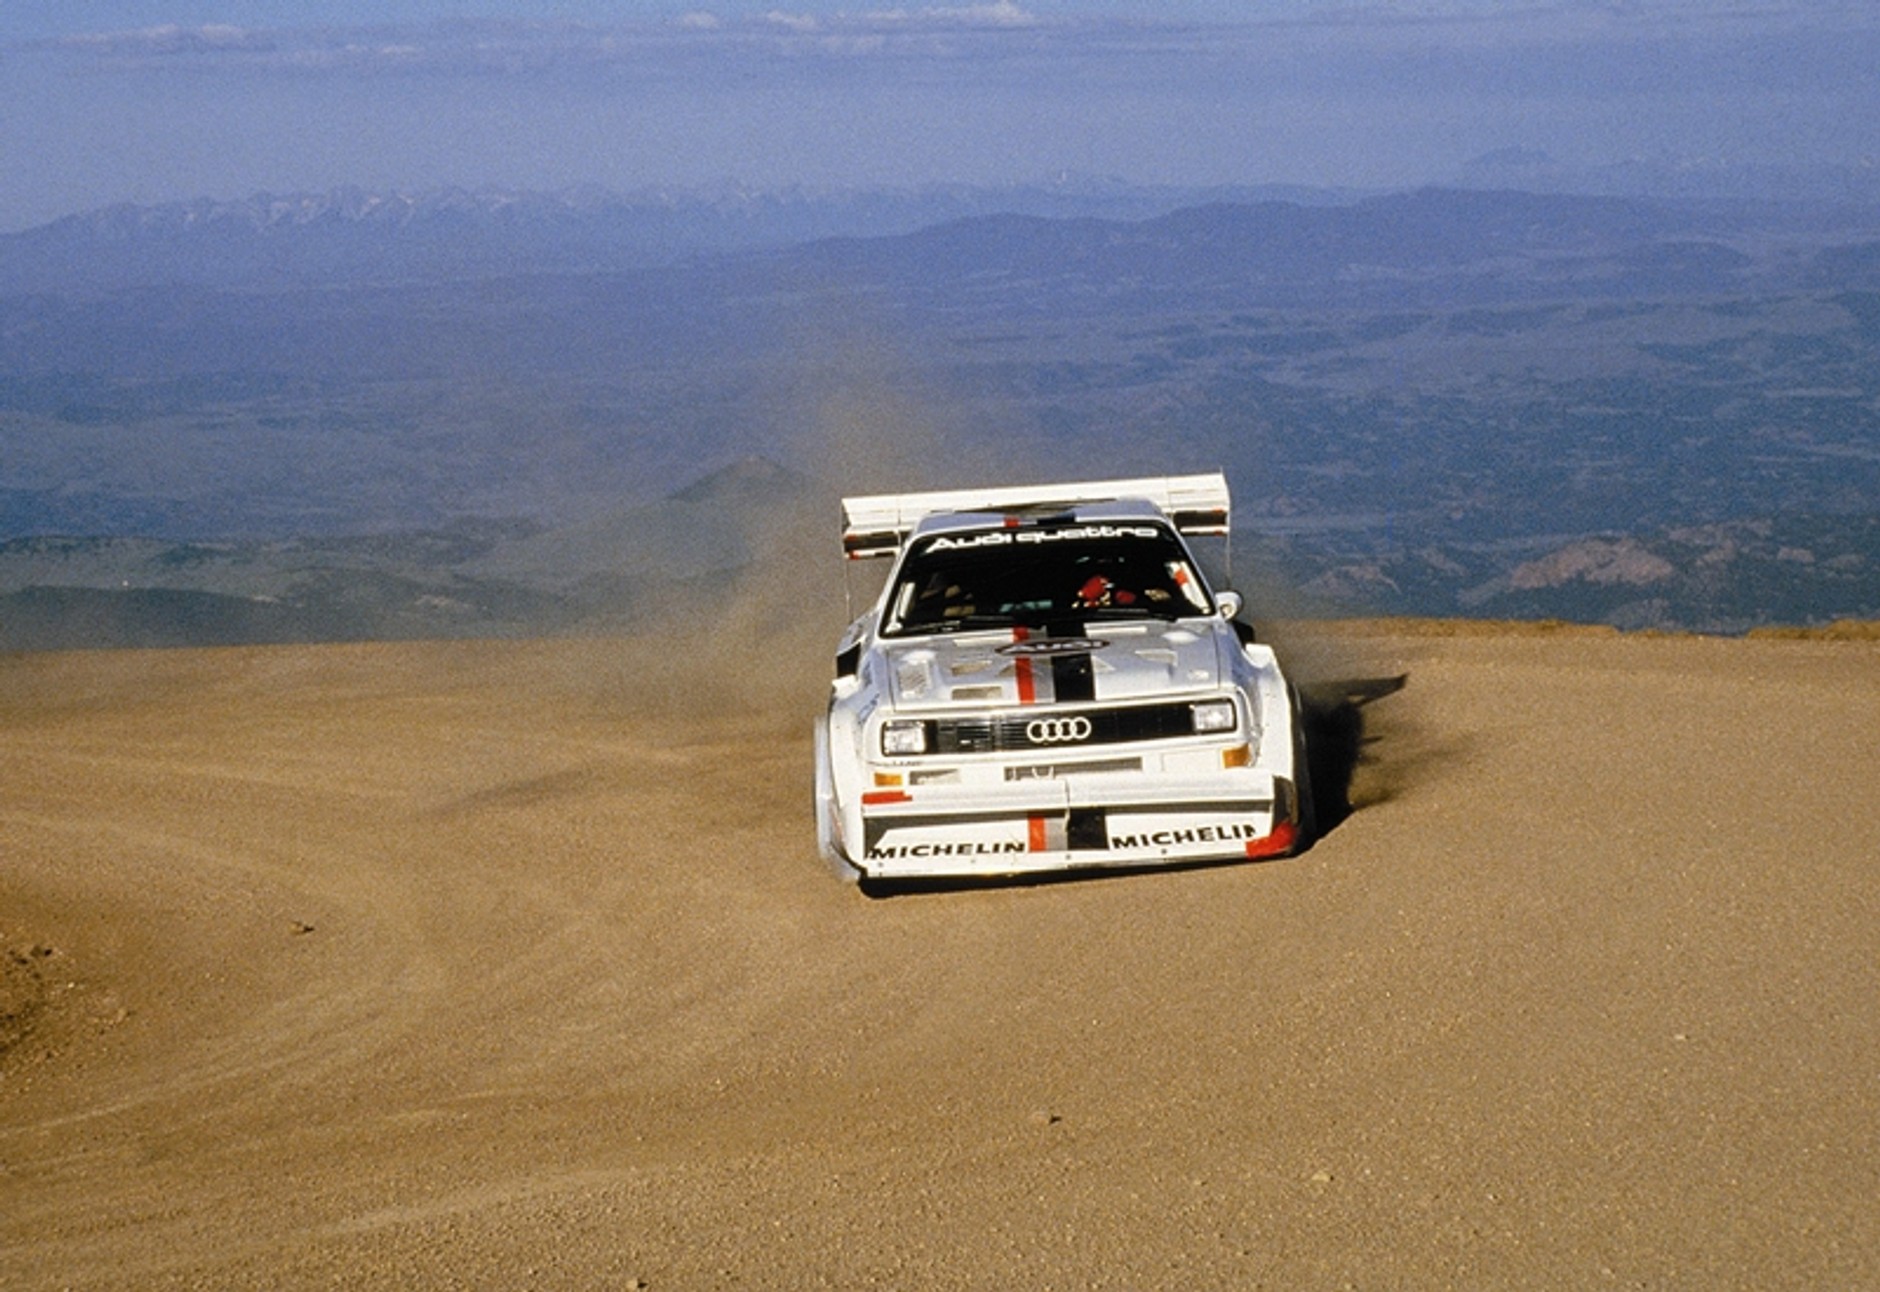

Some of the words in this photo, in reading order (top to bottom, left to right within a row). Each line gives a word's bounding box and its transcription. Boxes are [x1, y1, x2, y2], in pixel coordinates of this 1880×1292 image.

[925, 532, 1012, 553] Audi
[1015, 526, 1158, 543] quattro
[869, 842, 1026, 860] MICHELIN
